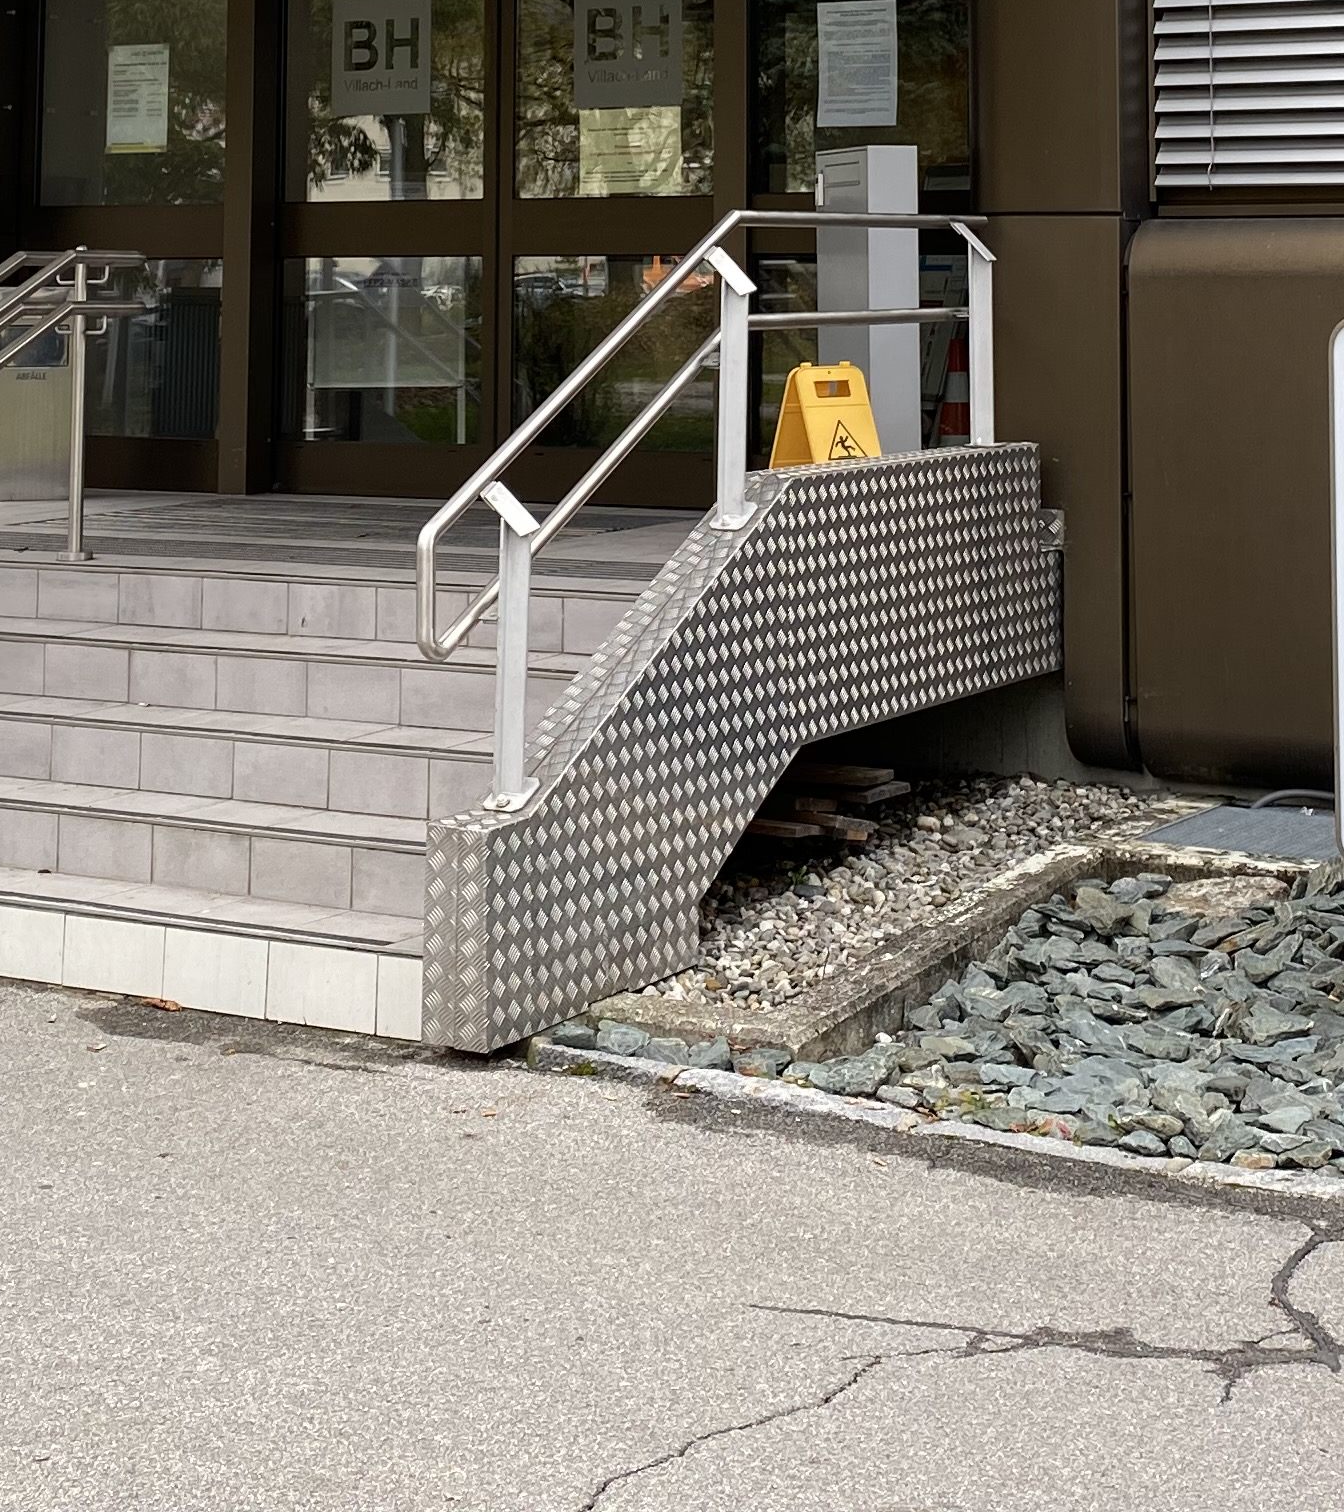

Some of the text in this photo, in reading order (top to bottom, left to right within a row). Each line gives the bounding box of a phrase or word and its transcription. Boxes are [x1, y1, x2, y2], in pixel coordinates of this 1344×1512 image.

[343, 18, 420, 72] BH
[587, 4, 670, 62] BH
[343, 76, 419, 92] Villach-Land
